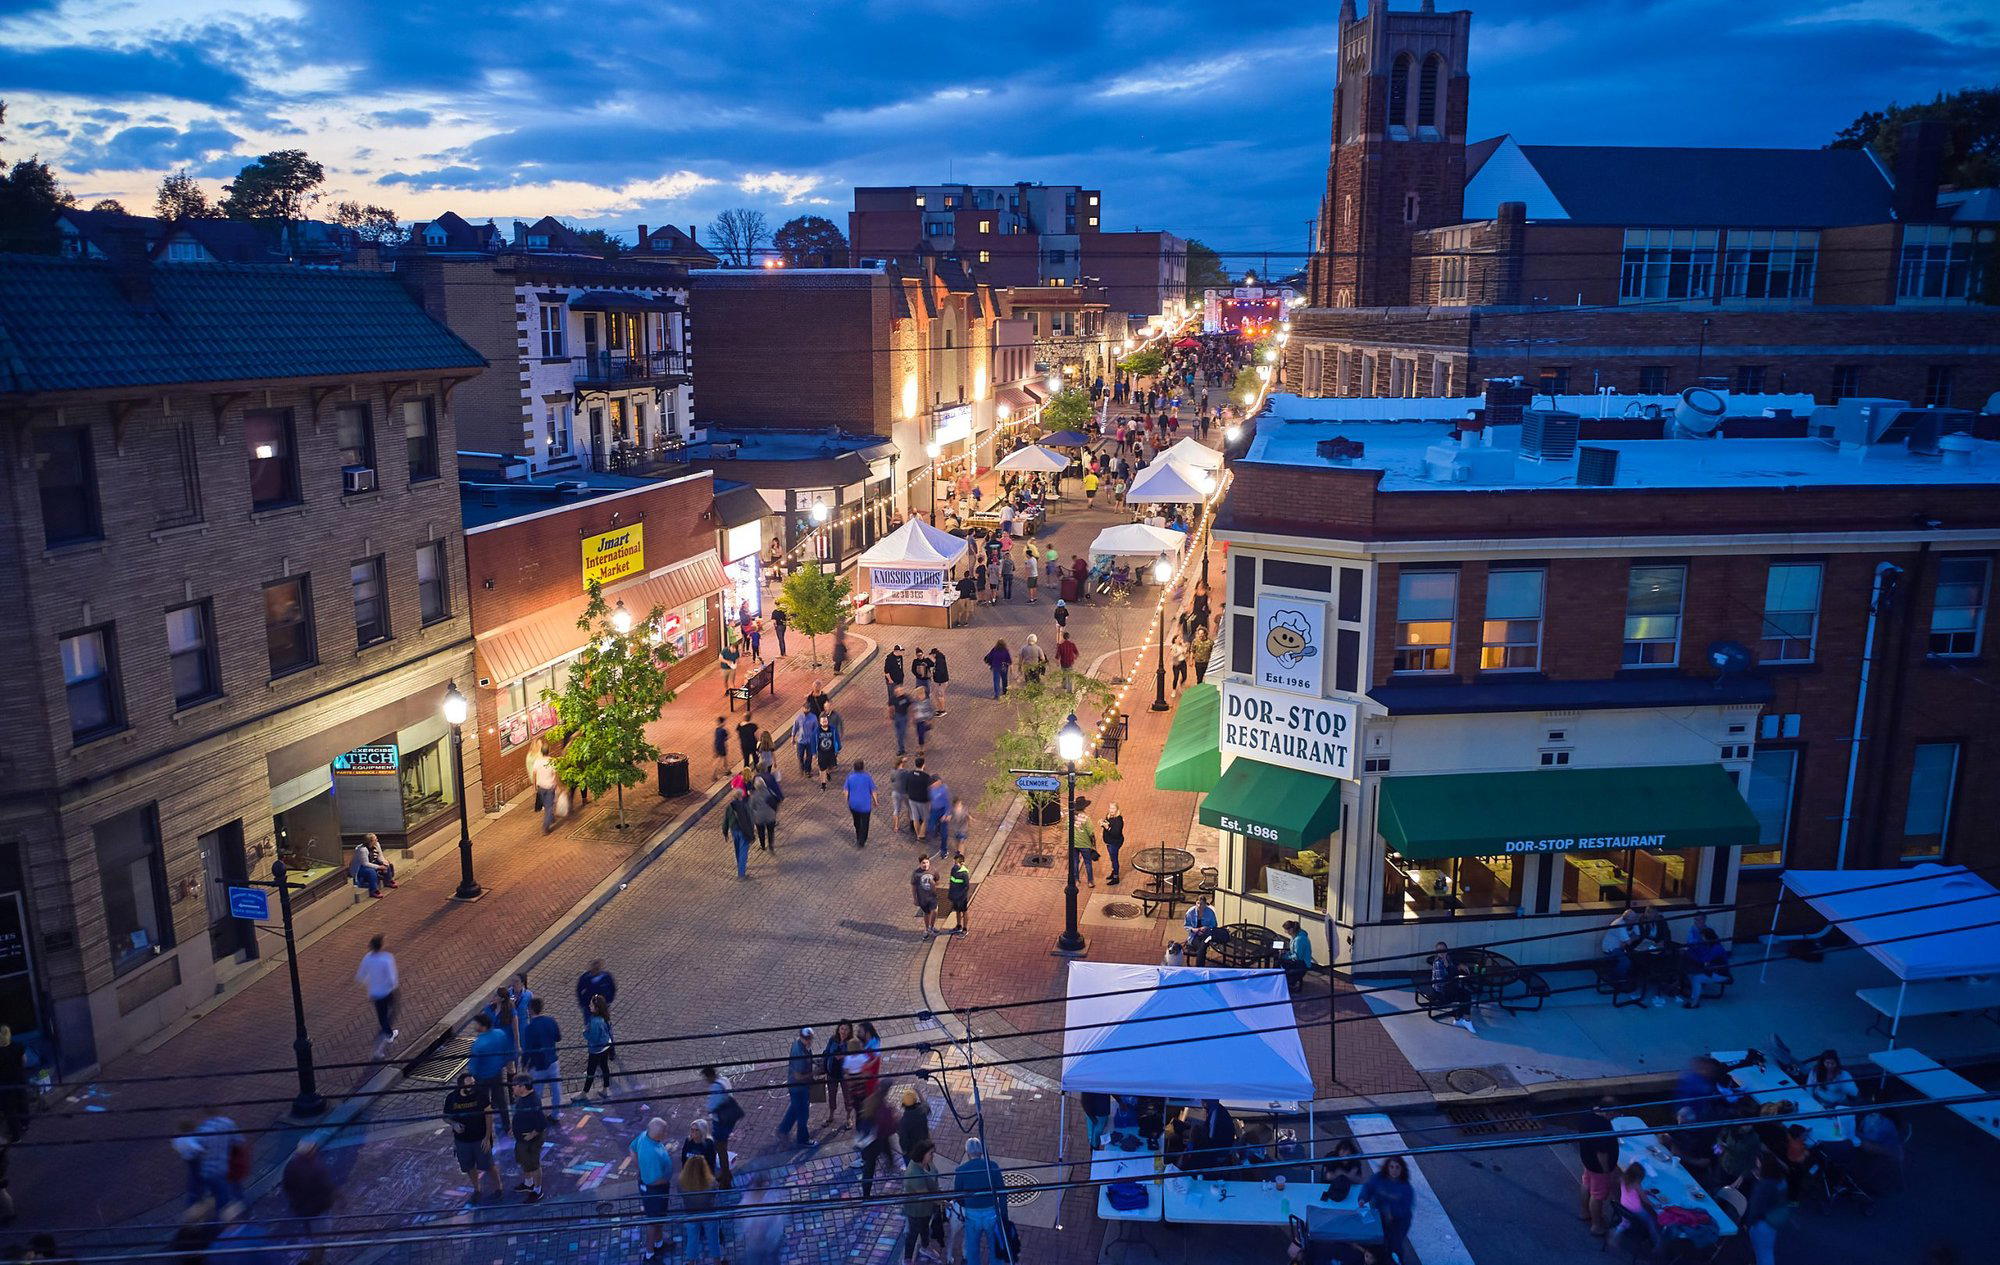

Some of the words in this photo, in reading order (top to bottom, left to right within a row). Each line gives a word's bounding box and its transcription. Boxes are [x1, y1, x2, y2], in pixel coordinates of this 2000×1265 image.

[598, 532, 630, 552] Jmart
[585, 541, 641, 569] International
[600, 560, 630, 578] Market
[874, 570, 911, 585] KNOSSOS
[913, 571, 941, 585] GYROS
[1266, 672, 1284, 684] Est.
[1286, 677, 1311, 689] 1986
[1228, 694, 1347, 738] DOR-STOP
[1226, 723, 1348, 768] RESTAURANT
[346, 753, 395, 764] TECH
[1018, 779, 1049, 787] GLENMORE
[1220, 816, 1242, 832] Est.
[1246, 823, 1279, 841] 1986
[1505, 838, 1574, 852] DOR-STOP
[1578, 834, 1666, 849] RESTAURANT
